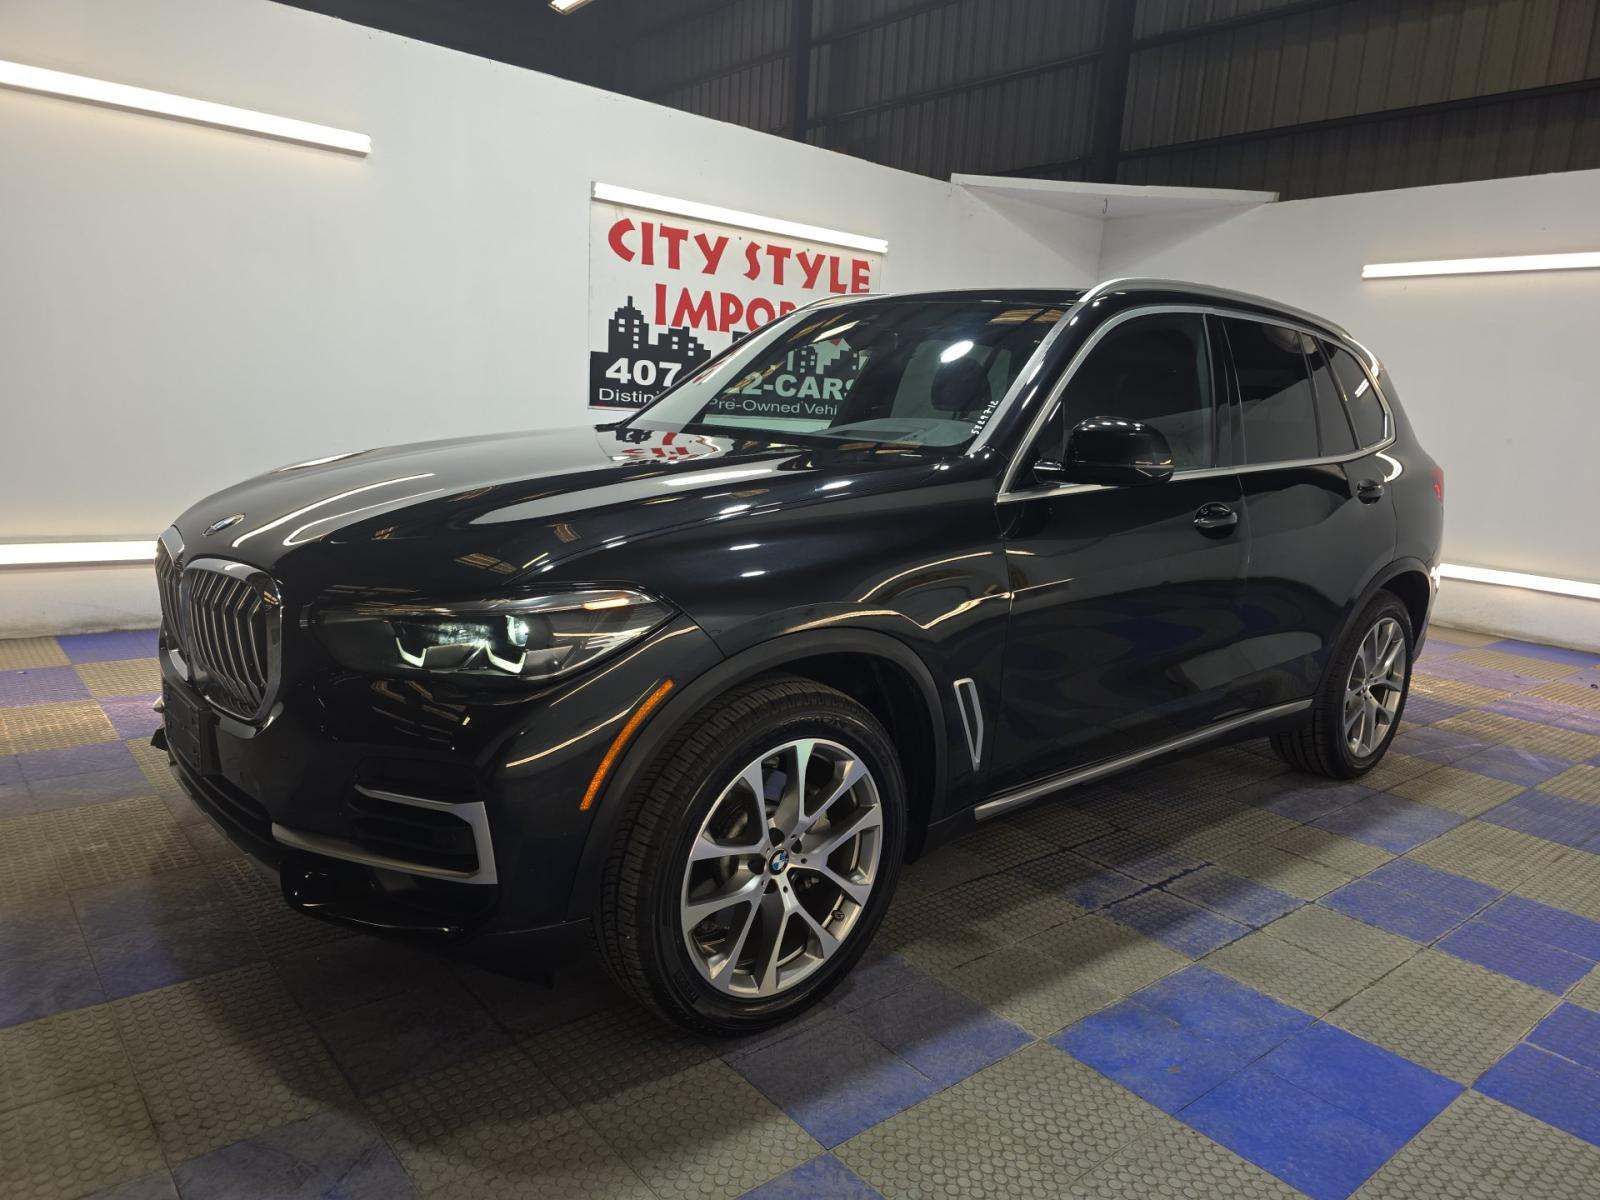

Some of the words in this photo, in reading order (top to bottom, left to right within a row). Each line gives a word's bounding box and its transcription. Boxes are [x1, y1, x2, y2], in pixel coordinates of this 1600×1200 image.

[607, 218, 730, 275] CITY
[743, 241, 871, 294] STYLE
[605, 357, 682, 387] 407
[598, 387, 656, 403] Distin
[804, 402, 838, 416] Vehi
